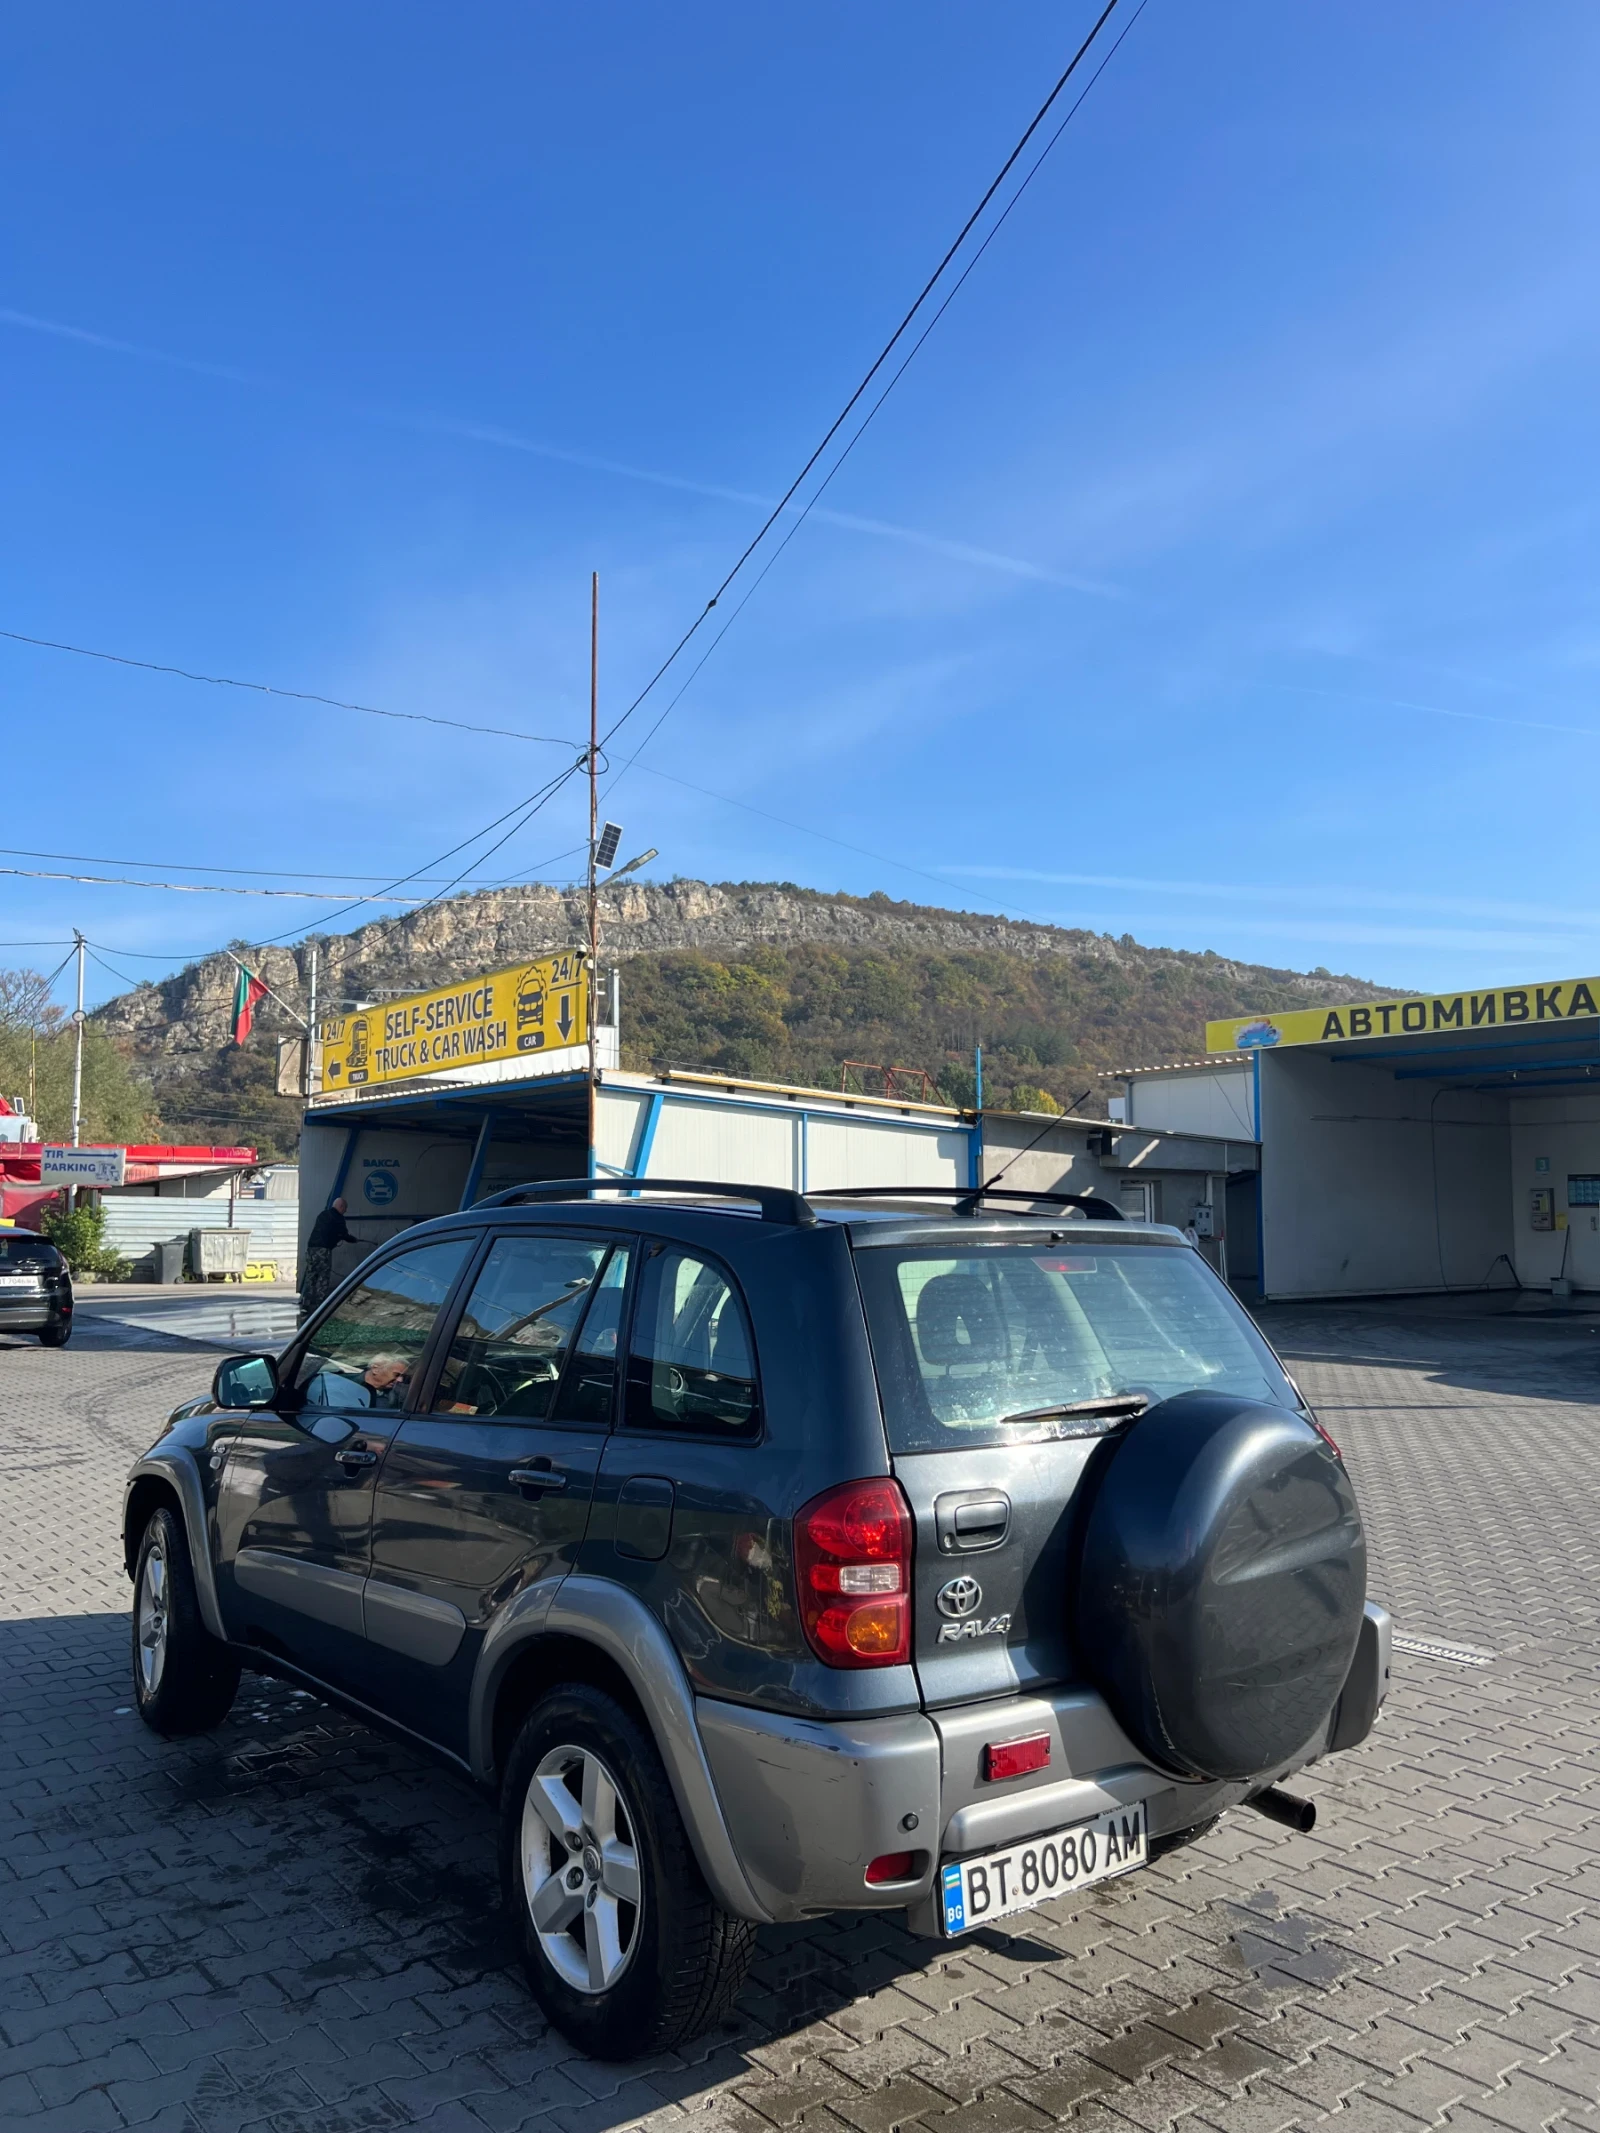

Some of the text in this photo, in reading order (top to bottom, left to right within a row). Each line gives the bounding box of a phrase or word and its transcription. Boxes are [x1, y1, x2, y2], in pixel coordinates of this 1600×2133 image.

[551, 953, 582, 983] 24/7
[385, 987, 493, 1041] SELF-SERVICE
[1321, 983, 1598, 1040] АВТОМИВКА
[326, 1019, 345, 1040] 24/7
[524, 1036, 537, 1047] CAR
[376, 1021, 507, 1073] TRUCK & CAR WASH
[44, 1162, 96, 1172] PARKING
[45, 1150, 64, 1159] TIR
[937, 1613, 1011, 1643] RAV4
[967, 1811, 1141, 1916] BT 8080 AM
[947, 1905, 963, 1923] BG
